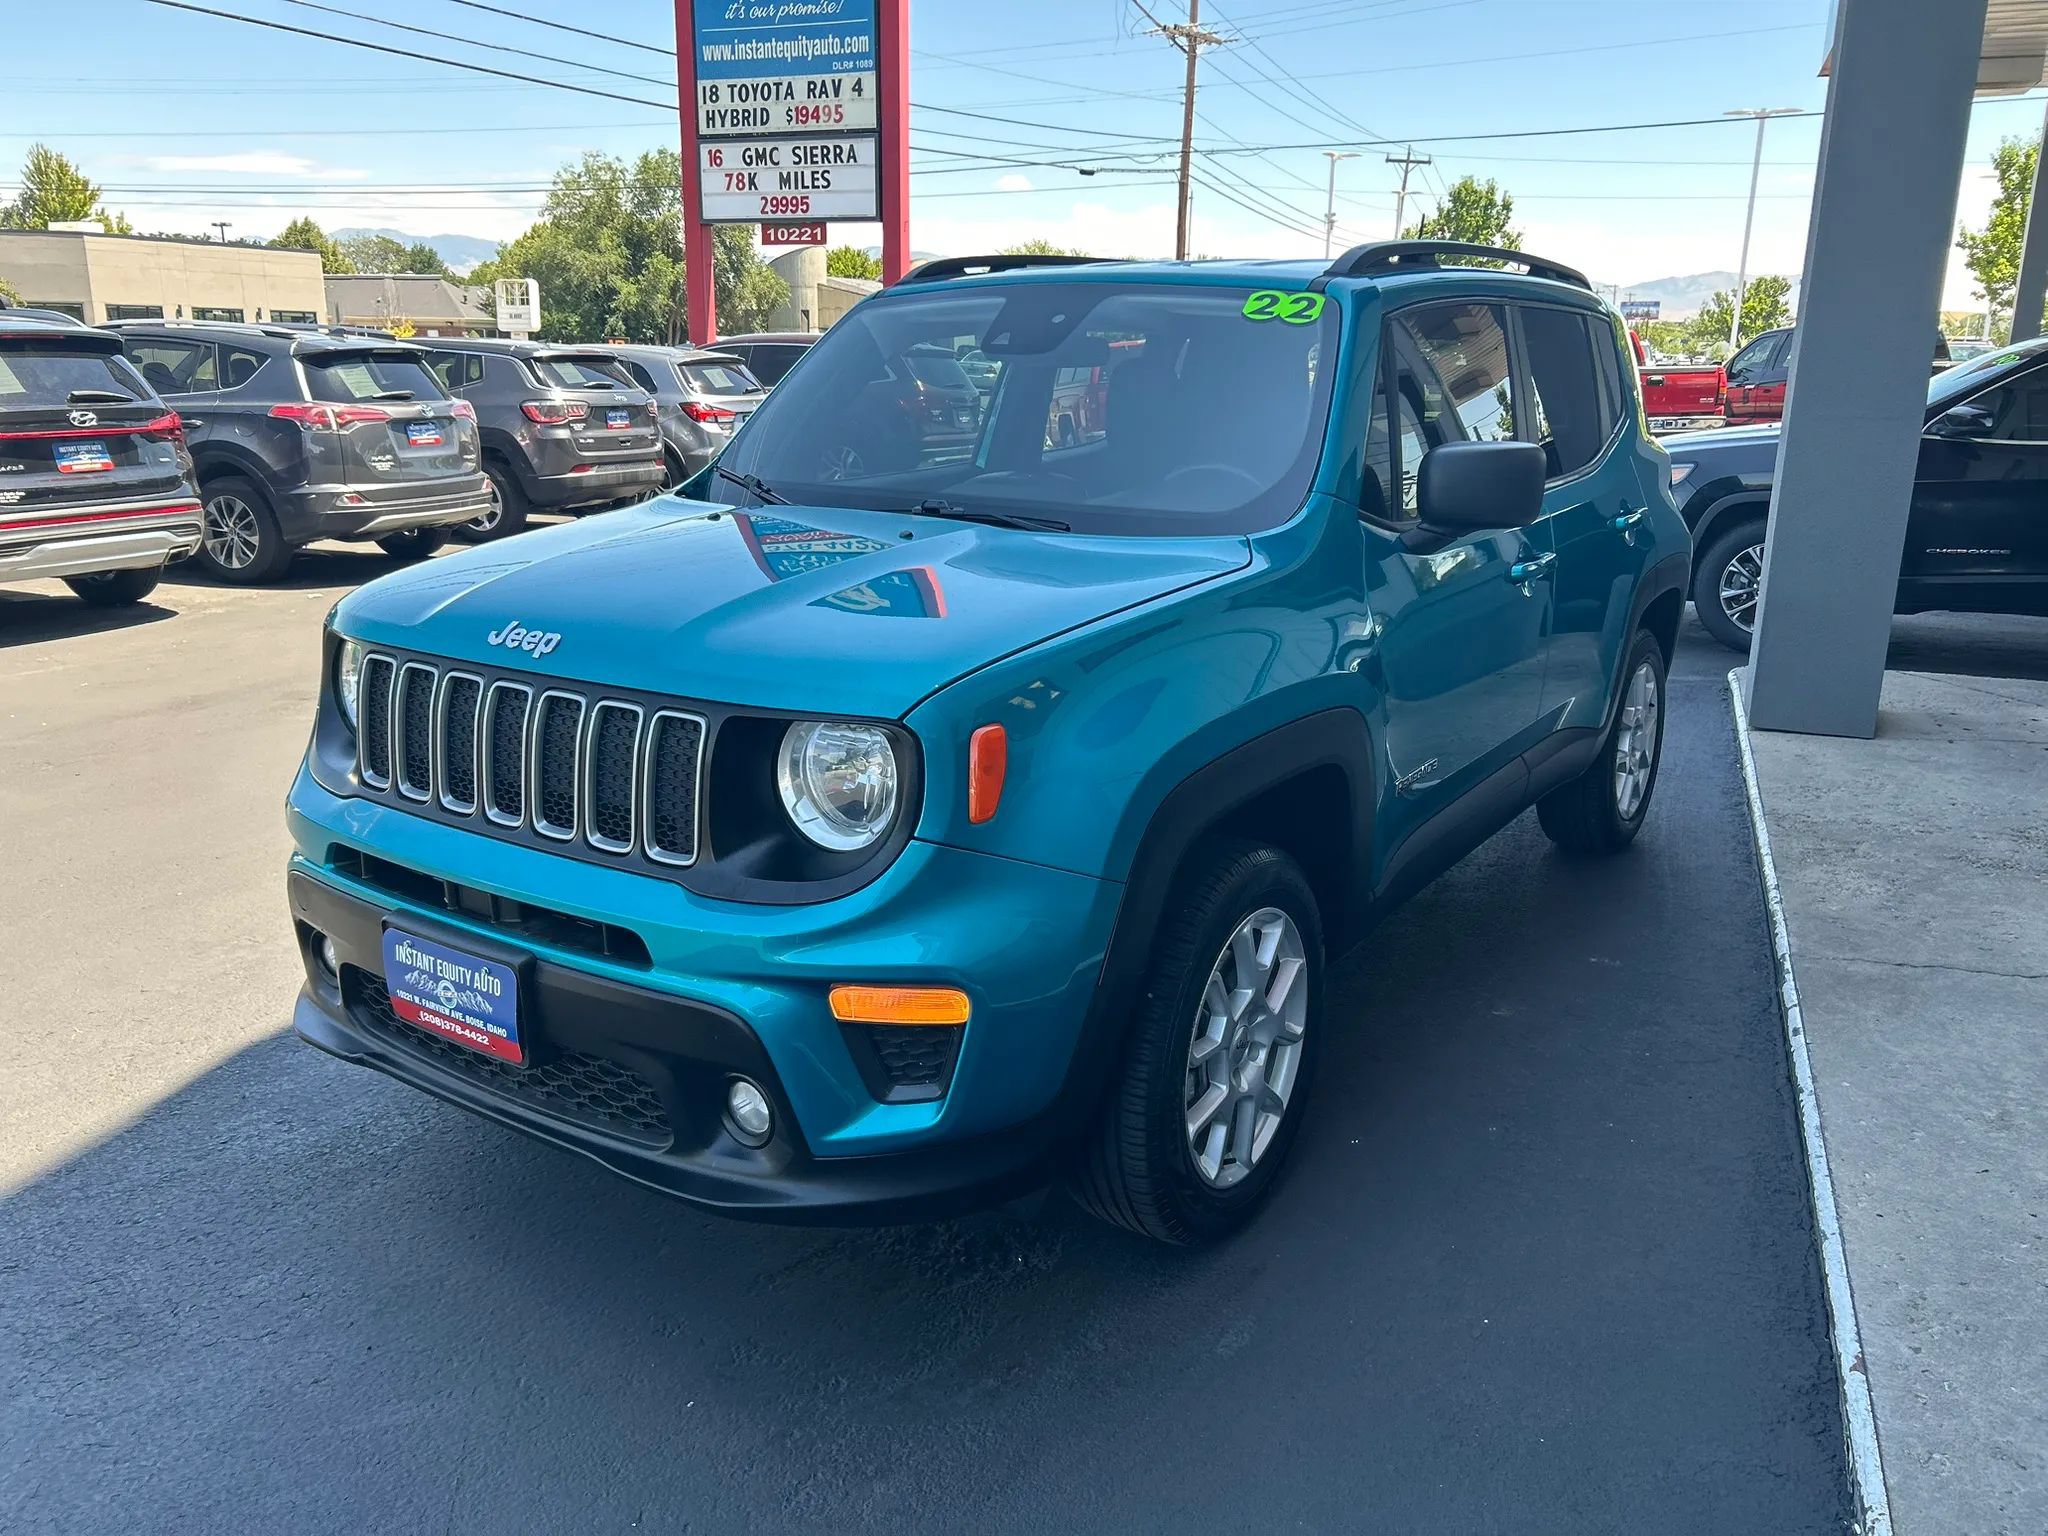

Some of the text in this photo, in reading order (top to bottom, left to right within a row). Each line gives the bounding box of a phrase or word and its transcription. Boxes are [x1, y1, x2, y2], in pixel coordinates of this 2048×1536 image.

[750, 7, 776, 18] our
[775, 0, 844, 24] promise!
[702, 34, 869, 62] www.instantequityauto.com
[832, 60, 873, 71] DLR# 1089
[702, 77, 863, 104] 18 TOYOTA RAV 4
[706, 104, 844, 128] HYBRID $19495
[707, 144, 858, 167] 16 GMC SIERRA
[724, 170, 831, 191] 78K MILES
[760, 196, 810, 214] 29995
[767, 227, 822, 241] 10221
[1245, 291, 1323, 322] 22
[487, 620, 562, 659] Jeep
[395, 943, 501, 997] INSTANT EQUITY AUTO
[422, 998, 450, 1016] FAIRVIEW
[486, 1022, 507, 1038] IDAHO
